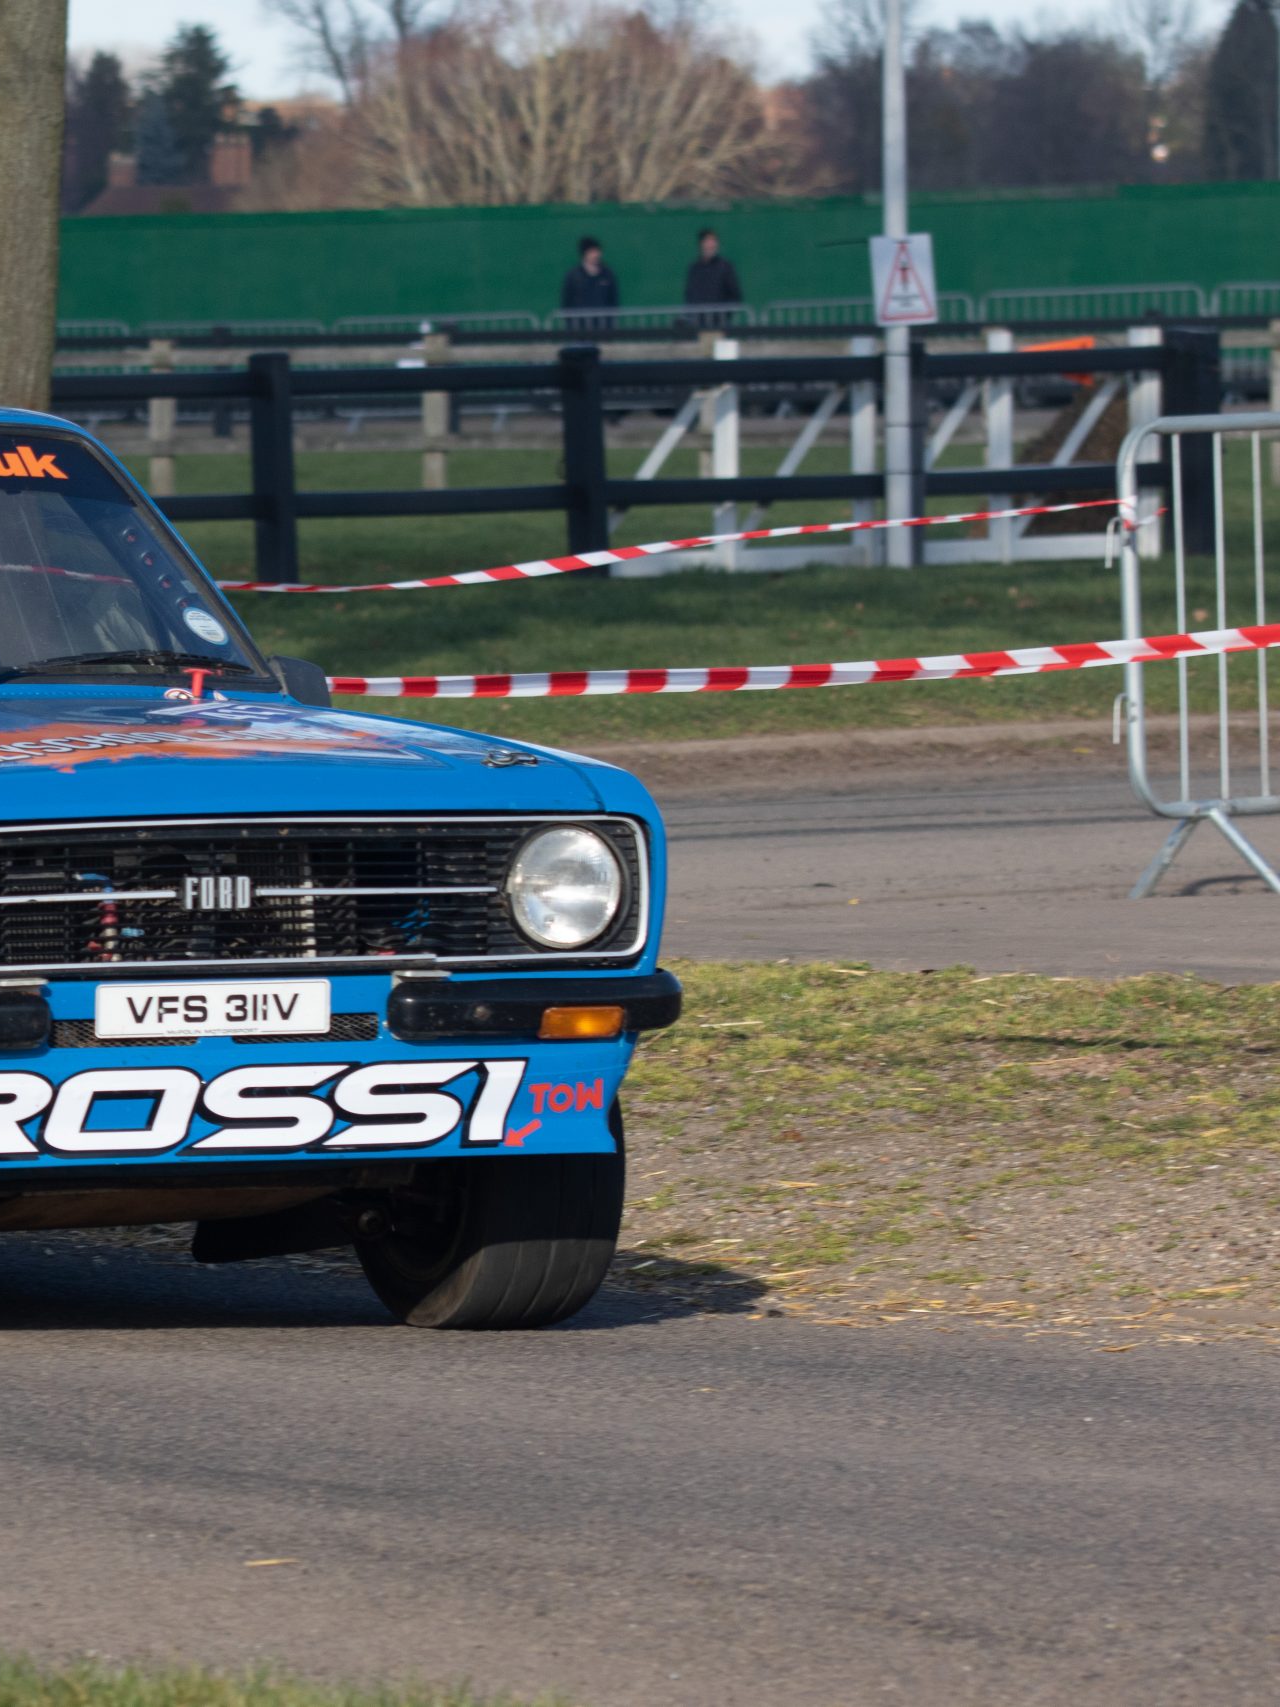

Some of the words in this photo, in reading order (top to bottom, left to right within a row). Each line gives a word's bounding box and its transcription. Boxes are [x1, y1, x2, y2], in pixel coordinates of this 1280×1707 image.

[185, 876, 251, 909] FORD
[127, 996, 208, 1024] VFS
[226, 993, 299, 1022] 311V
[529, 1078, 604, 1114] TOW
